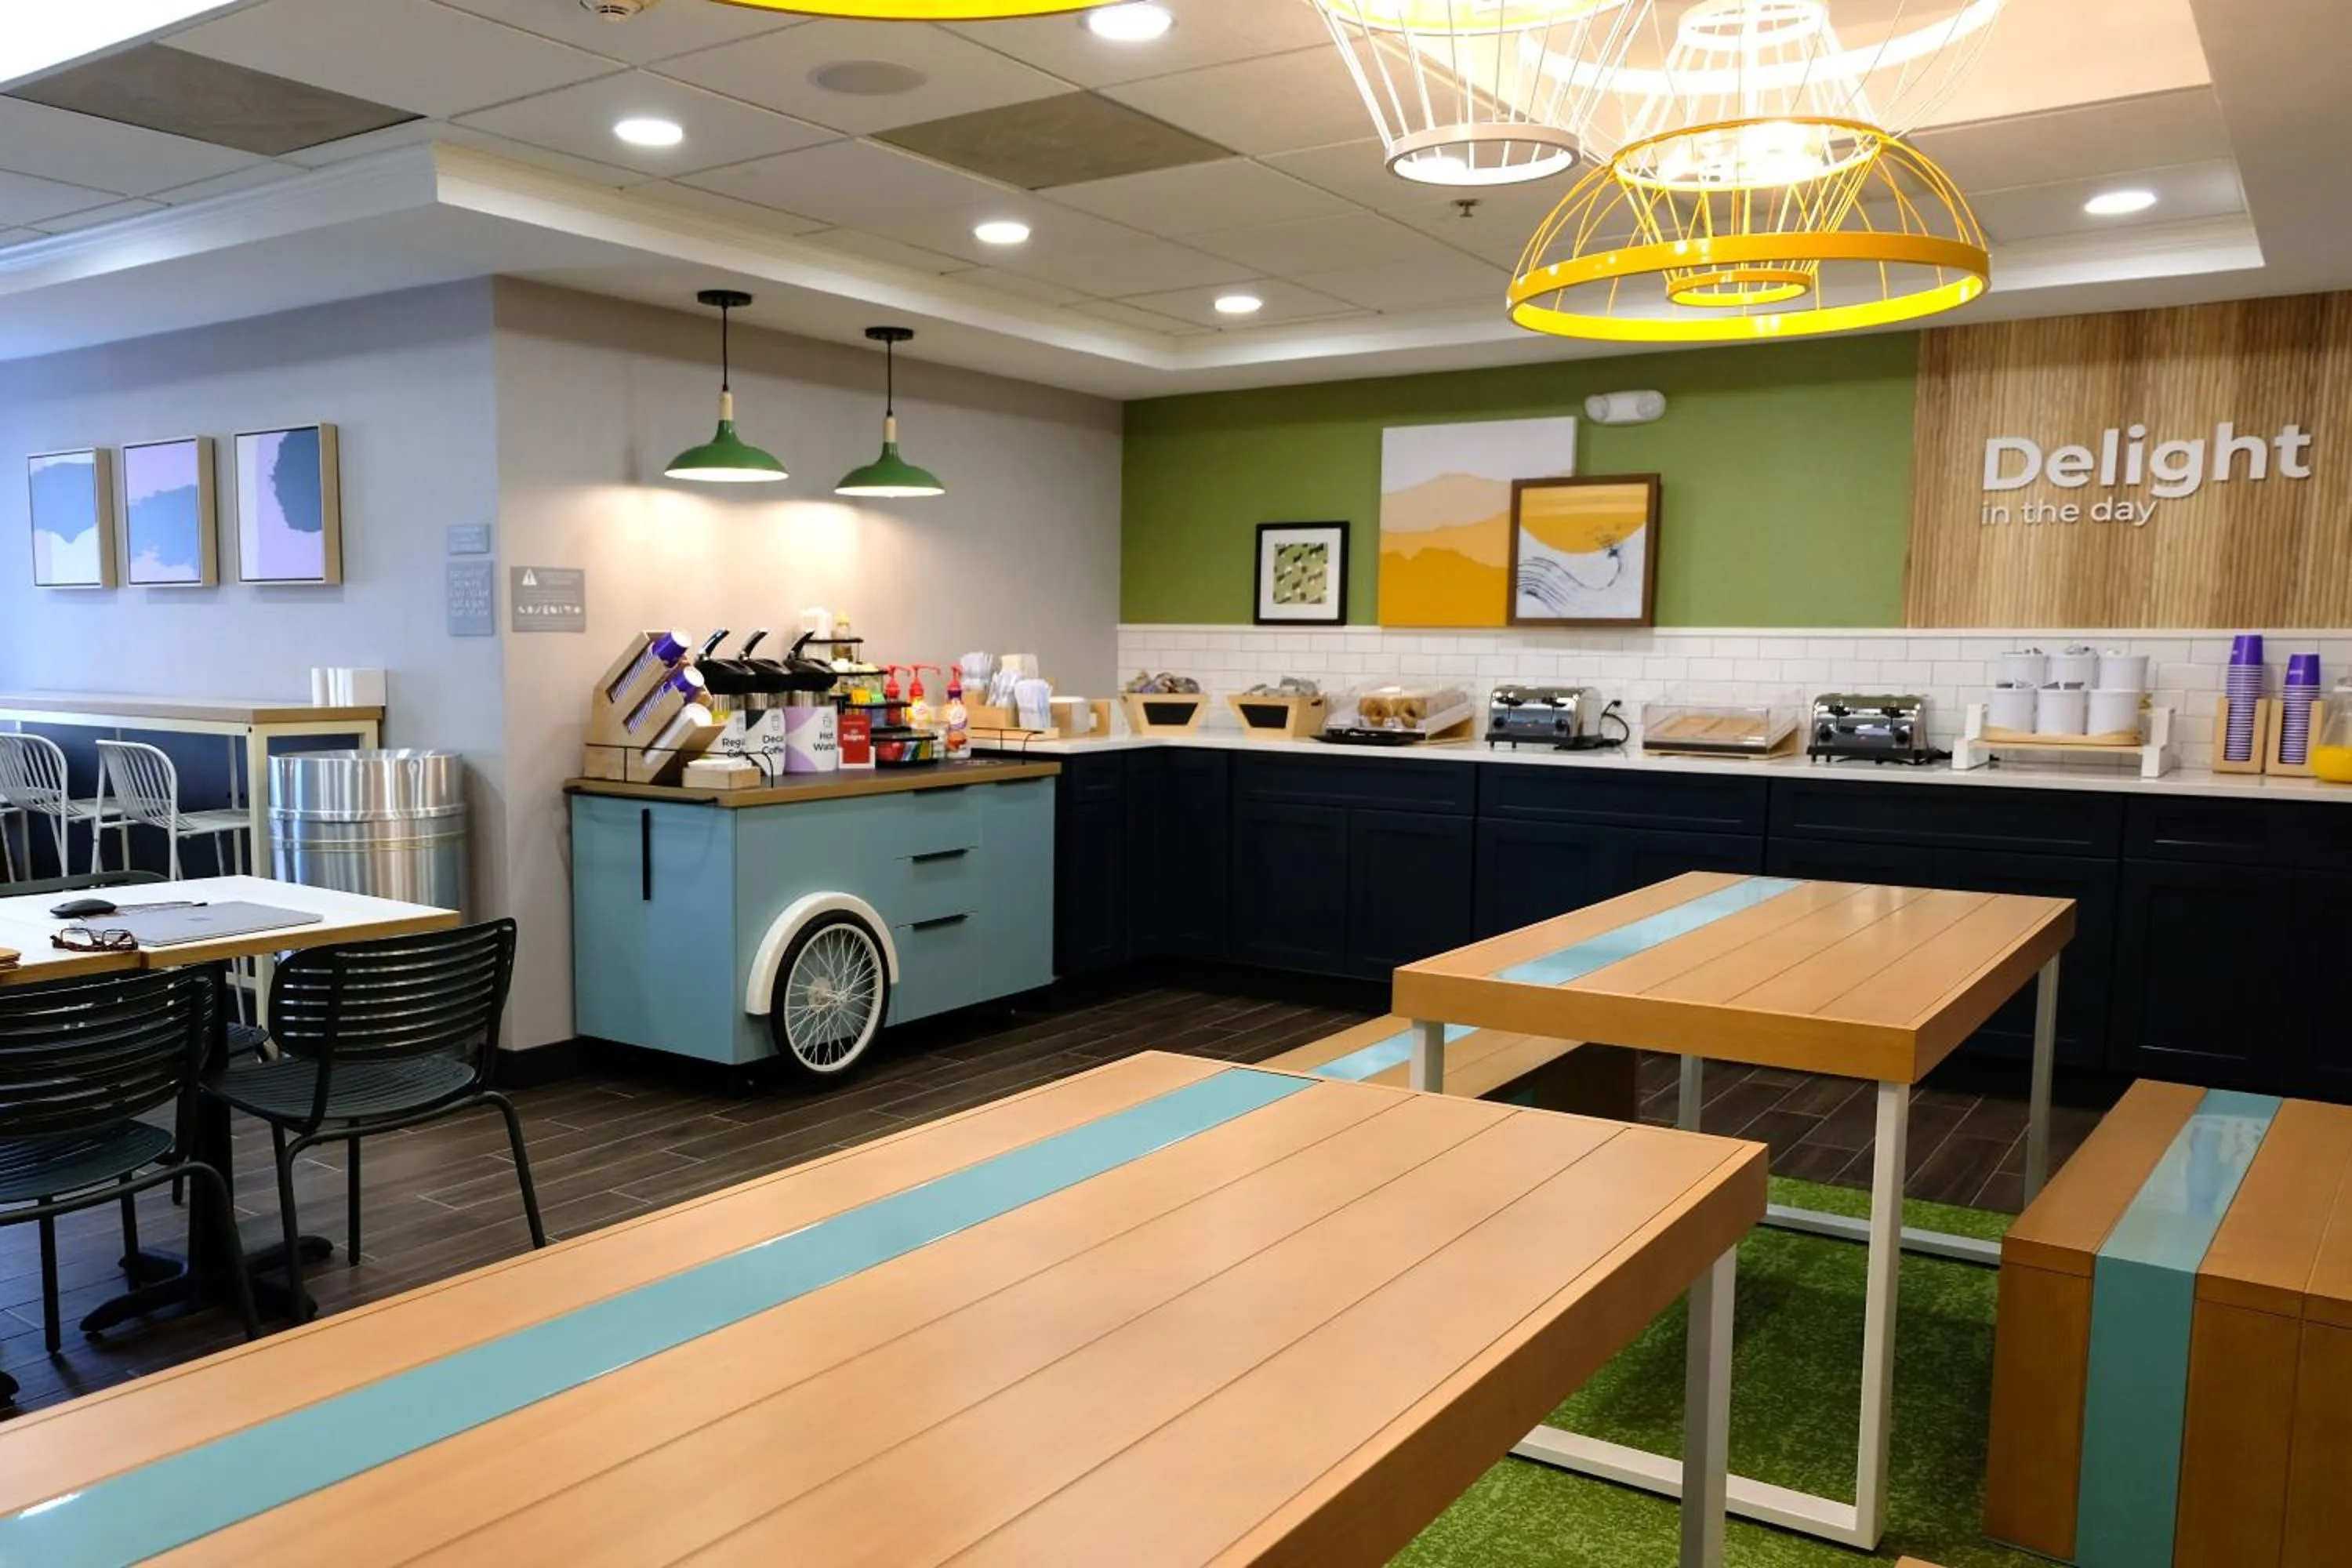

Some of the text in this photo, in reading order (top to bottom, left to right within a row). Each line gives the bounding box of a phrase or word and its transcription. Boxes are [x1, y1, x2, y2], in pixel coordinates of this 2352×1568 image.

[1983, 421, 2312, 499] Delight
[1982, 495, 2158, 526] in the day
[819, 731, 834, 740] Hot
